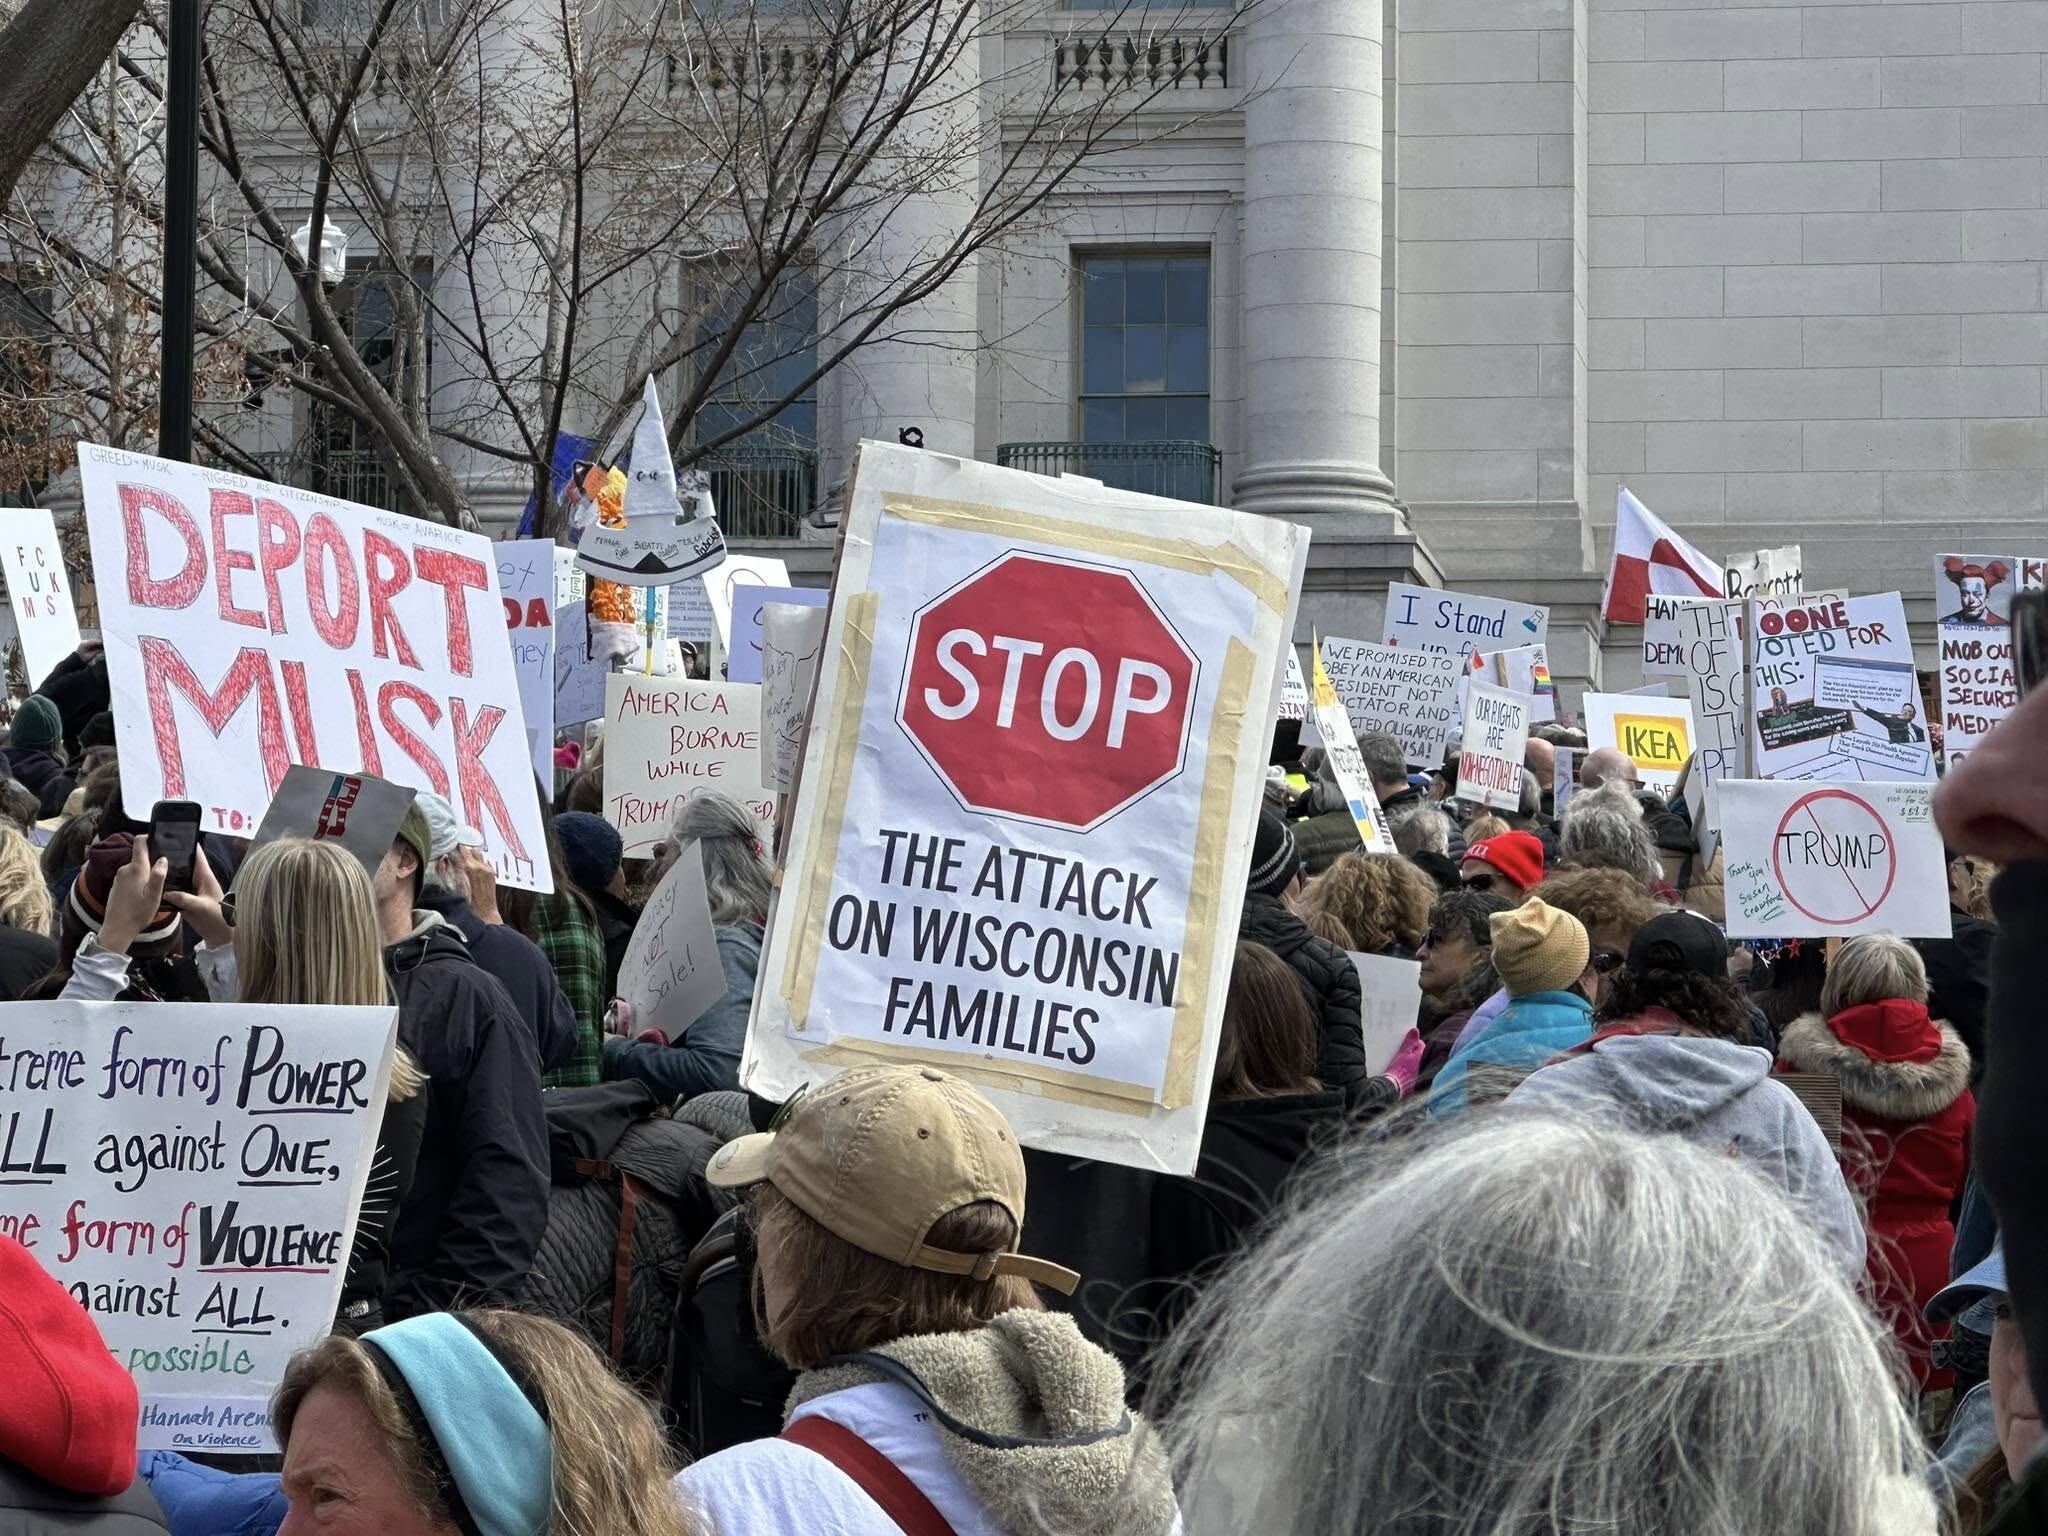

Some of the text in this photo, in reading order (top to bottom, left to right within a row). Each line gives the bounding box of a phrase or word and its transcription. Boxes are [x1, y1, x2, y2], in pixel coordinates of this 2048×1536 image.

[116, 482, 489, 678] DEPORT
[1434, 600, 1506, 639] Stand
[1847, 622, 1892, 649] FOR
[1328, 644, 1353, 660] WE
[1355, 647, 1427, 668] PROMISED
[1431, 656, 1453, 671] TO
[1691, 639, 1728, 675] OF
[1942, 640, 1982, 660] MOB
[923, 627, 1173, 750] STOP
[1321, 661, 1455, 688] OBEY AN AMERICAN
[618, 686, 728, 723] AMERICA
[1407, 687, 1443, 702] NOT
[1416, 705, 1450, 722] AND
[1475, 696, 1522, 730] OUR RIGHTS
[138, 635, 532, 862] MUSK
[1384, 720, 1446, 744] OLIGARCH
[1485, 726, 1505, 751] ARE
[1626, 726, 1682, 762] IKEA
[648, 760, 727, 780] WHILE
[212, 806, 253, 830] TO:
[1777, 831, 1887, 869] TRUMP
[877, 829, 1159, 929] THE ATTACK
[828, 893, 1180, 1008] ON WISCONSIN
[646, 943, 696, 1016] Sale!
[882, 976, 1100, 1066] FAMILIES
[98, 1026, 187, 1099] form
[193, 1036, 232, 1105] of
[94, 1120, 226, 1192] against
[57, 1199, 155, 1263] form
[163, 1201, 196, 1269] of
[195, 1286, 290, 1328] ALL.
[128, 1336, 255, 1375] possible
[140, 1403, 214, 1428] Hannah
[197, 1432, 262, 1447] Violence
